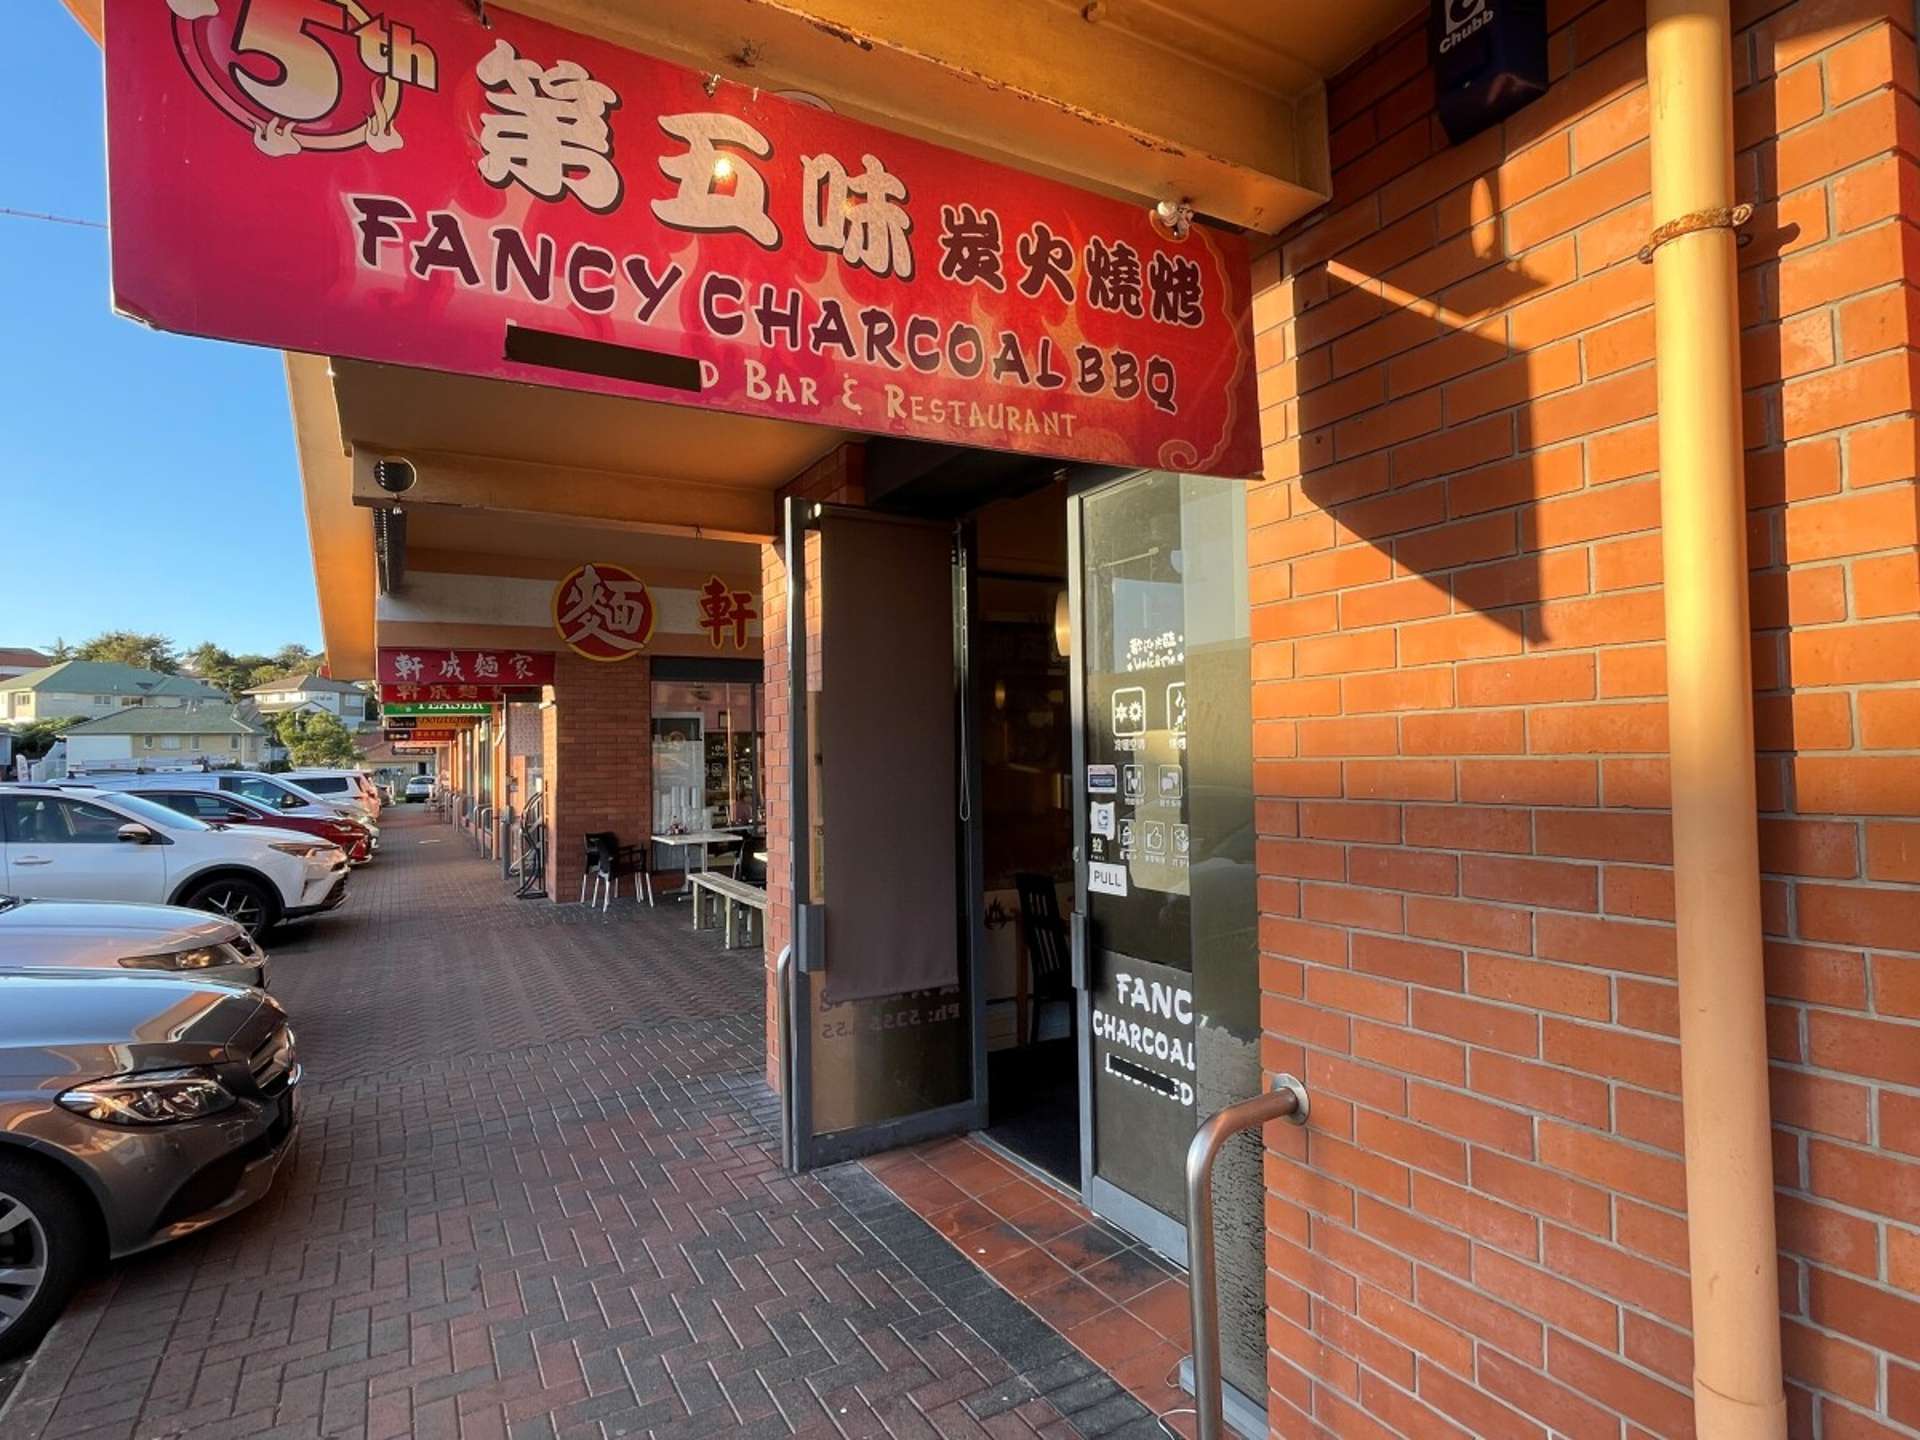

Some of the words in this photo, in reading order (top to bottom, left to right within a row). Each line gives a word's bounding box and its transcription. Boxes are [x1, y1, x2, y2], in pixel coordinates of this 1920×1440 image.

[229, 0, 438, 125] 5th
[1439, 9, 1495, 54] Chubb
[477, 39, 915, 282] 第五味
[345, 193, 683, 323] FANCY
[701, 274, 1064, 389] CHARCOAL
[1075, 345, 1177, 415] BBQ
[558, 563, 647, 651] 麵
[1093, 869, 1122, 887] PULL
[1116, 973, 1208, 1027] FANC
[1092, 1009, 1196, 1072] CHARCOAL
